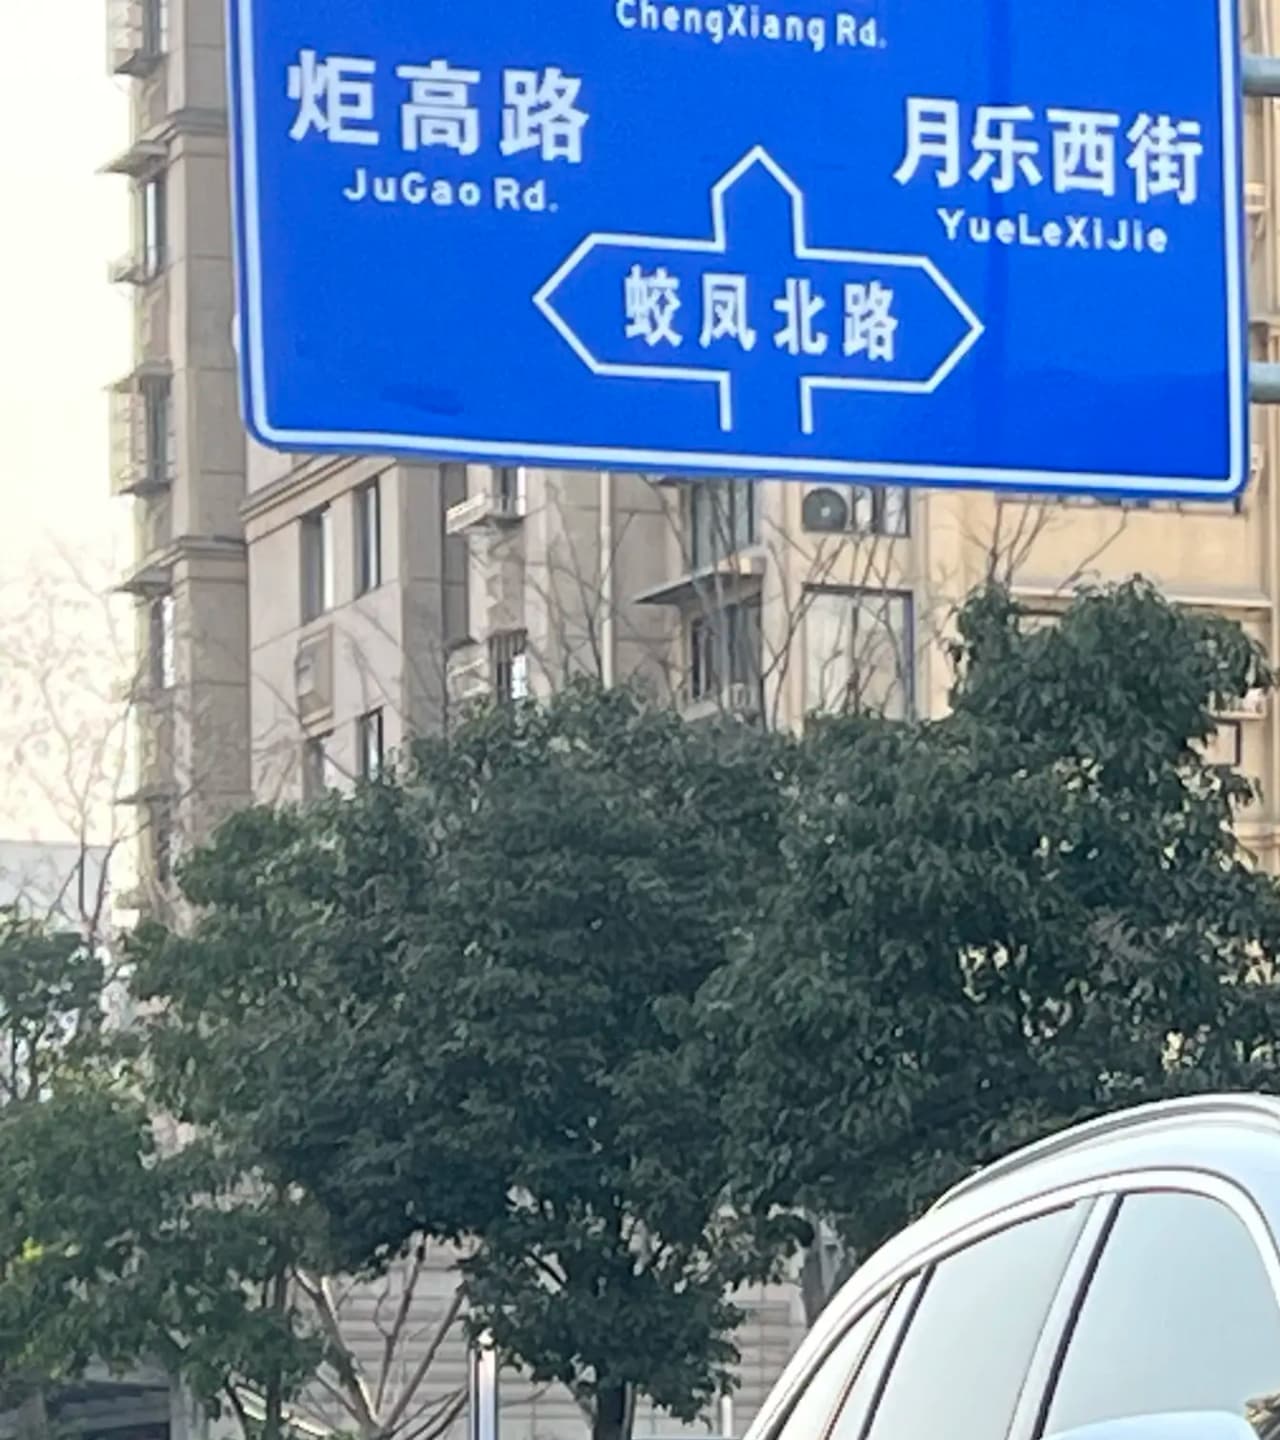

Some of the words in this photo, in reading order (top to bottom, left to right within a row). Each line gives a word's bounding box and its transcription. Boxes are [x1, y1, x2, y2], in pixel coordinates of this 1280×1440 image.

[615, 0, 826, 52] ChengXiang
[836, 12, 887, 49] Rd.
[287, 49, 590, 164] 炬高路
[892, 96, 1204, 205] 月乐西街
[343, 167, 481, 206] JuGao
[493, 176, 559, 213] Rd.
[624, 263, 899, 362] 蛟凤北路
